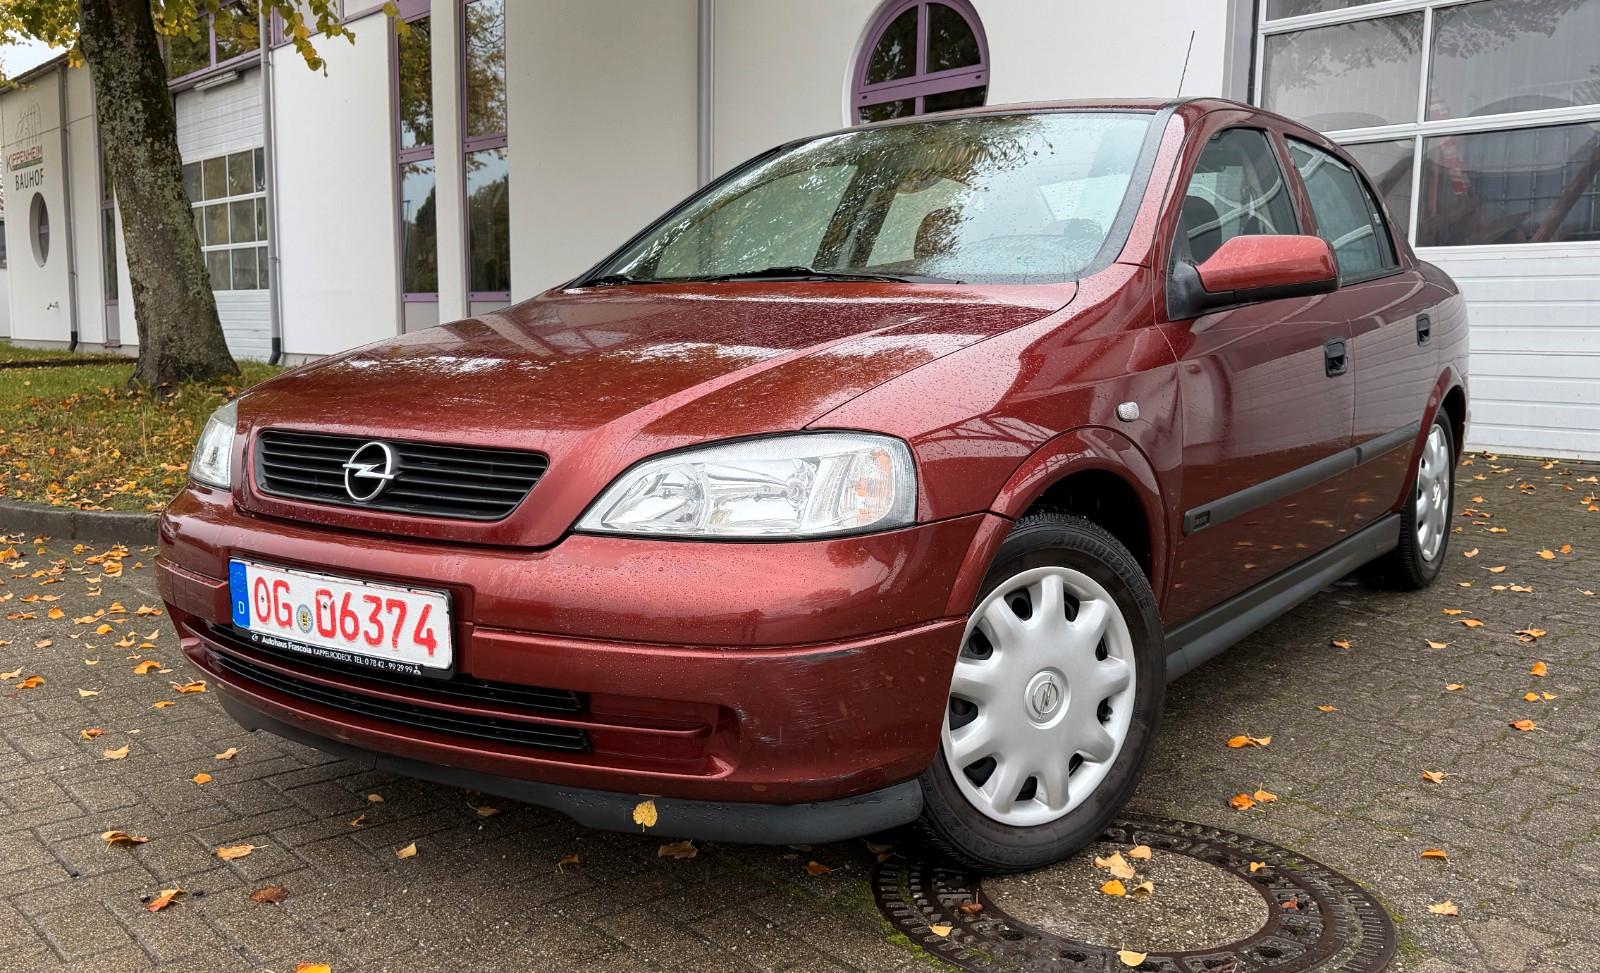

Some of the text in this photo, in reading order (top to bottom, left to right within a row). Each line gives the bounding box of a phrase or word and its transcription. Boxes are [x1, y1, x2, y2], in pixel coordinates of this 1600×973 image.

[6, 144, 43, 174] KIPPENHEIM
[15, 168, 44, 191] BAUHOF
[238, 600, 245, 615] D
[253, 576, 437, 657] OG 06374
[262, 636, 287, 649] Autohaus
